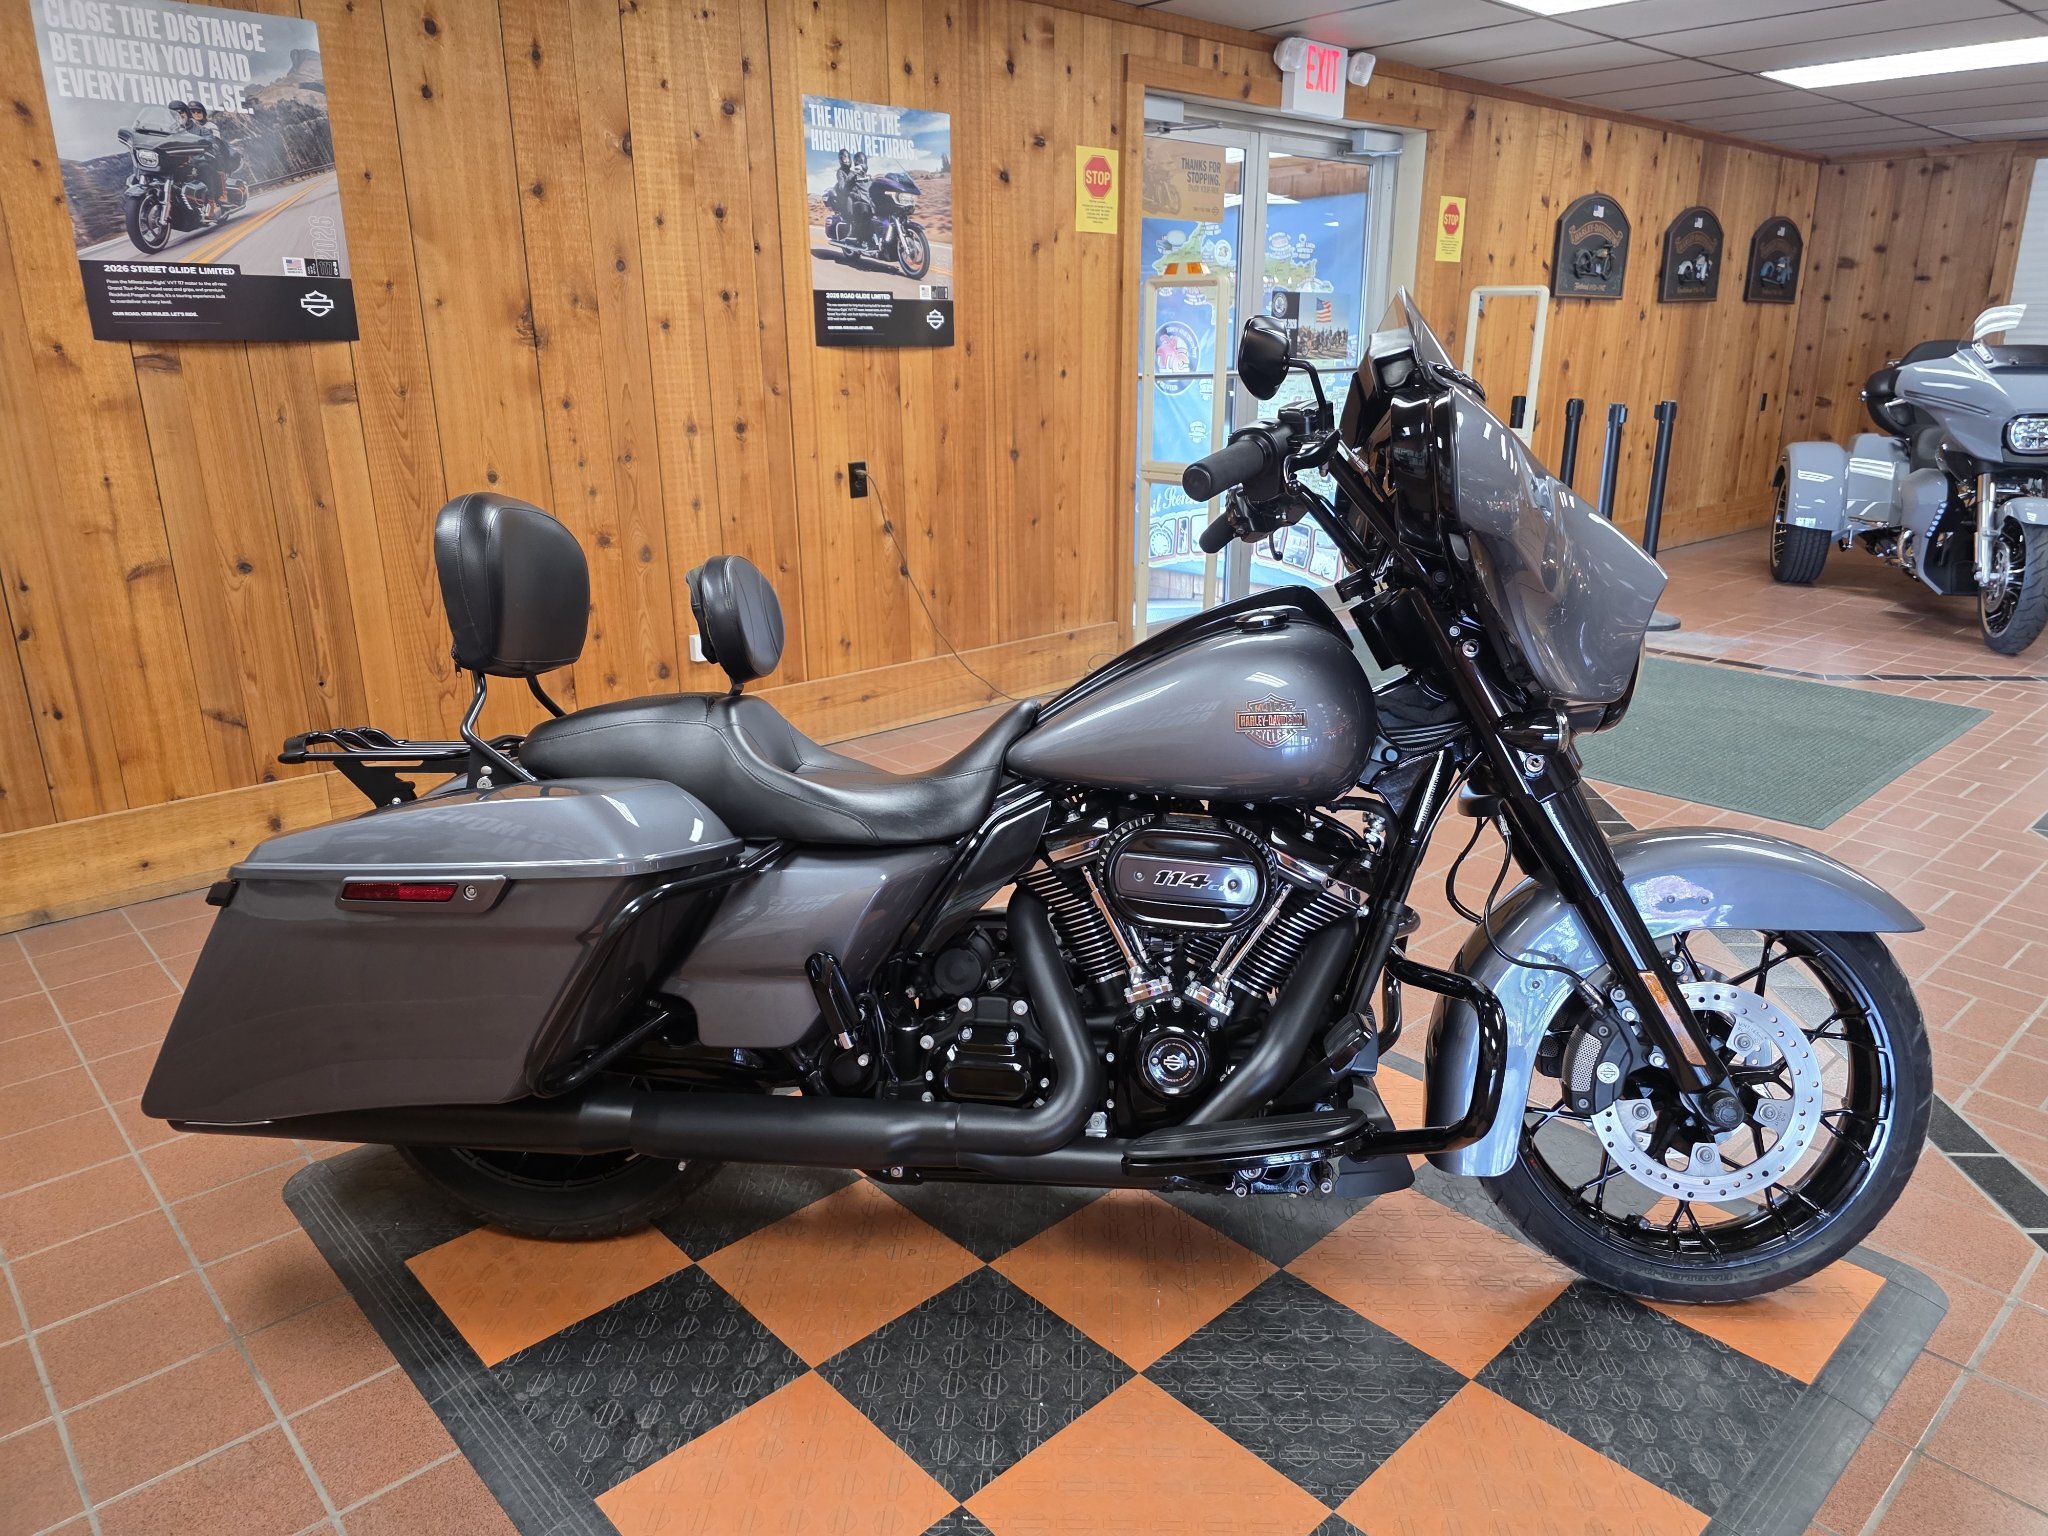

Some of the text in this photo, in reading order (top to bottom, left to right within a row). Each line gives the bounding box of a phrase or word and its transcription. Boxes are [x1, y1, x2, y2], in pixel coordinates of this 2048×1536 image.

[42, 0, 266, 52] CLOSE THE DISTANCE
[48, 31, 251, 82] BETWEEN YOU AND
[1305, 44, 1341, 94] EXIT
[55, 66, 254, 115] EVERYTHING ELSE.
[809, 103, 902, 136] THE KING OF THE
[810, 128, 862, 153] HIGHWAY
[1181, 157, 1221, 174] THANKS FOR
[1085, 169, 1111, 186] STOP
[1186, 171, 1221, 186] STOPPING.
[1443, 213, 1459, 226] STOP
[104, 264, 235, 276] 2026 STREET GLIDE LIMITED
[1240, 713, 1303, 727] HARLEY-DAVIDSON
[1255, 729, 1288, 743] CYCLES
[1153, 869, 1213, 889] 114
